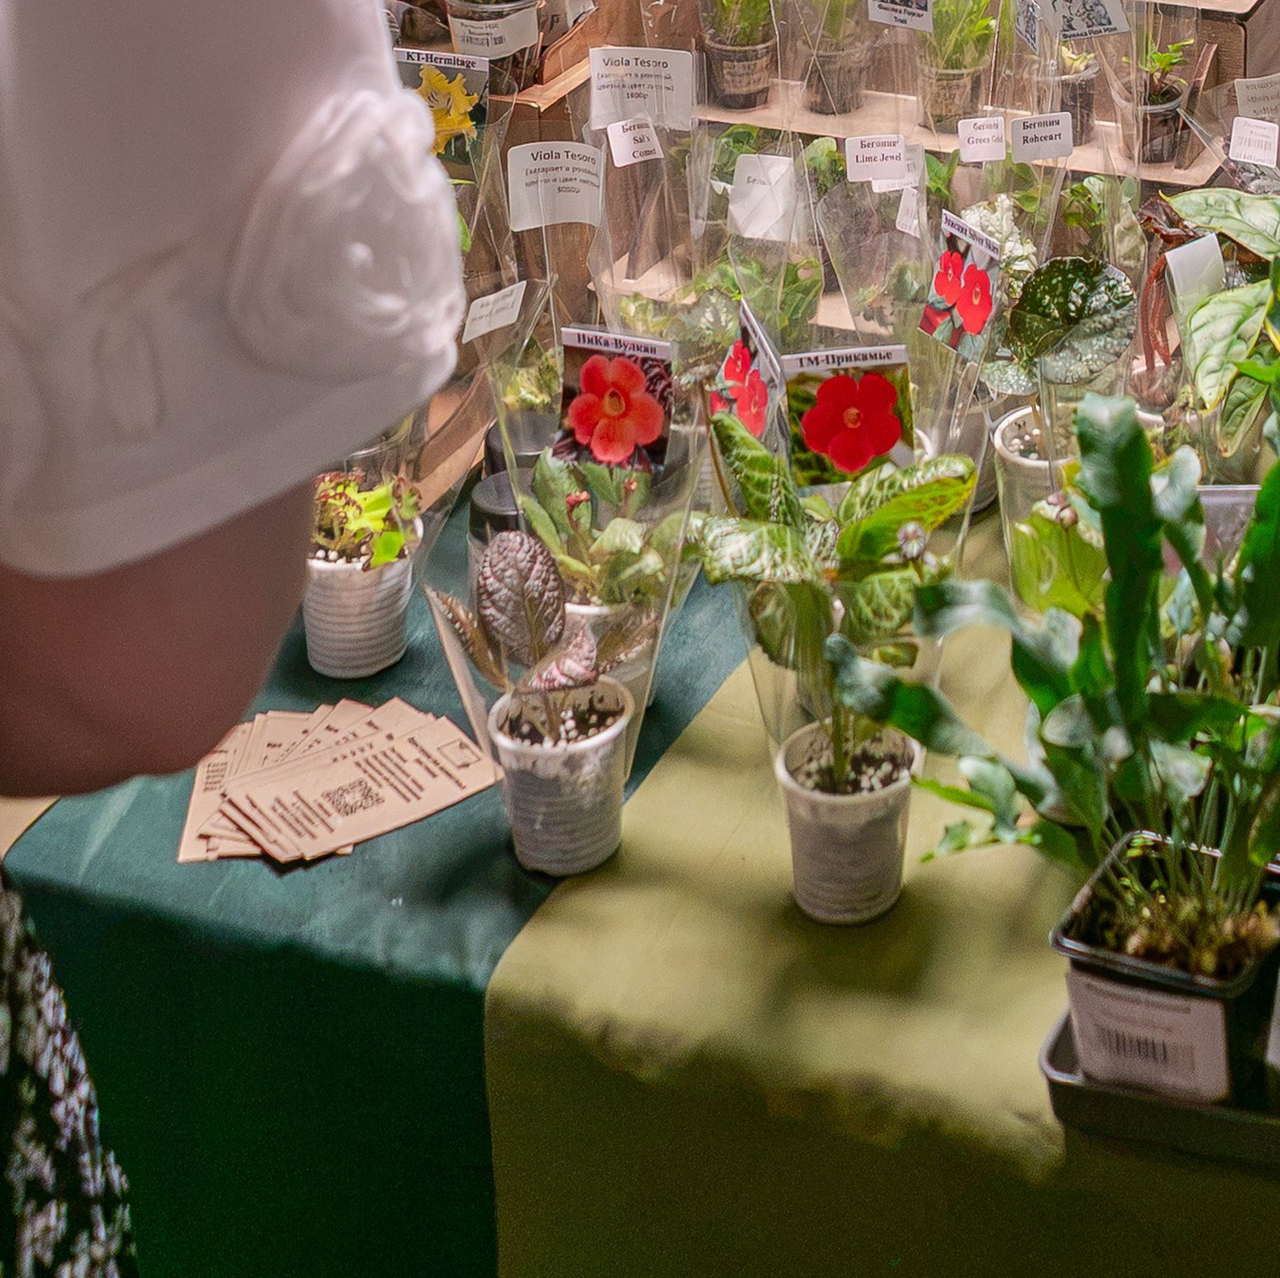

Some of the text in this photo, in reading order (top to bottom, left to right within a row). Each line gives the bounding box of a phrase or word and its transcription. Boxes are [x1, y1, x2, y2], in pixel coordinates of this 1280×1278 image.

[405, 50, 477, 68] KT-Hermitage
[602, 56, 669, 69] Viola Tesoro
[1022, 118, 1061, 131] Бегония
[860, 139, 899, 149] Бегония
[530, 150, 597, 166] Viola Tesoro
[855, 152, 902, 164] Lime Jewel
